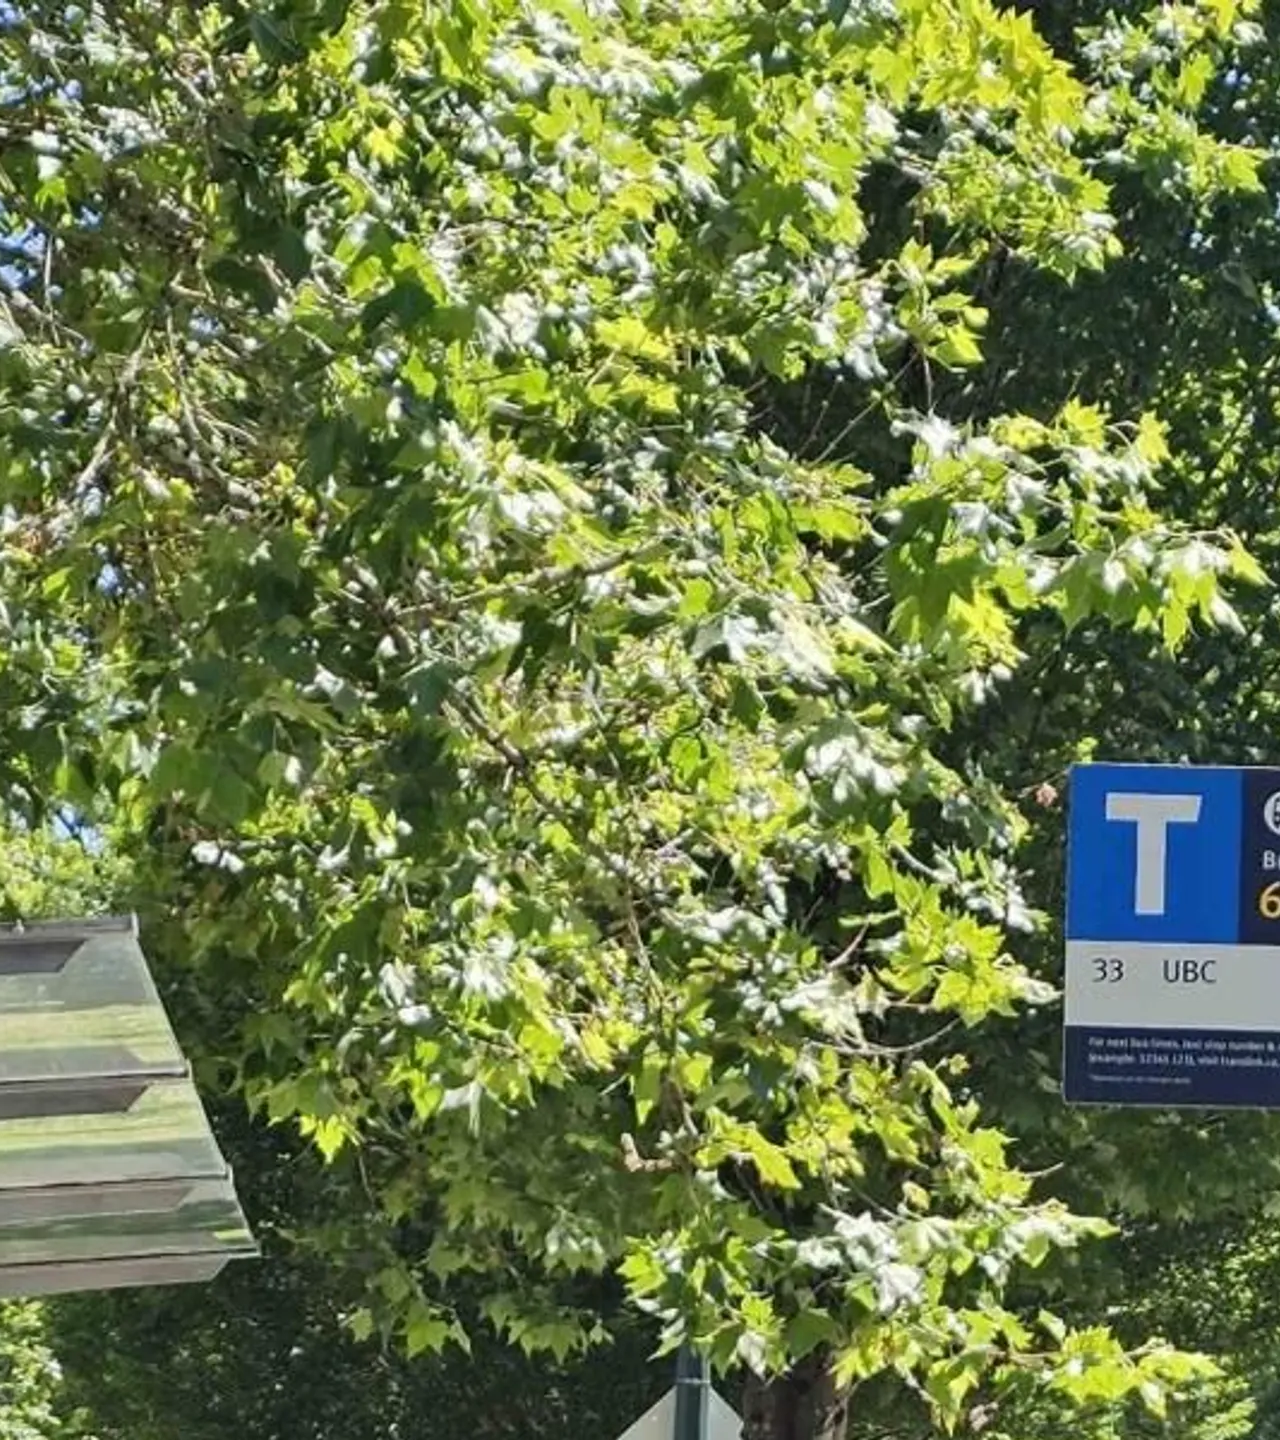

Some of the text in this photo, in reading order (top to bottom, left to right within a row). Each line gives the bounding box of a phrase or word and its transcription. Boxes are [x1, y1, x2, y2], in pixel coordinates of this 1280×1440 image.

[1105, 792, 1202, 915] T
[1091, 958, 1217, 984] 33 UBC
